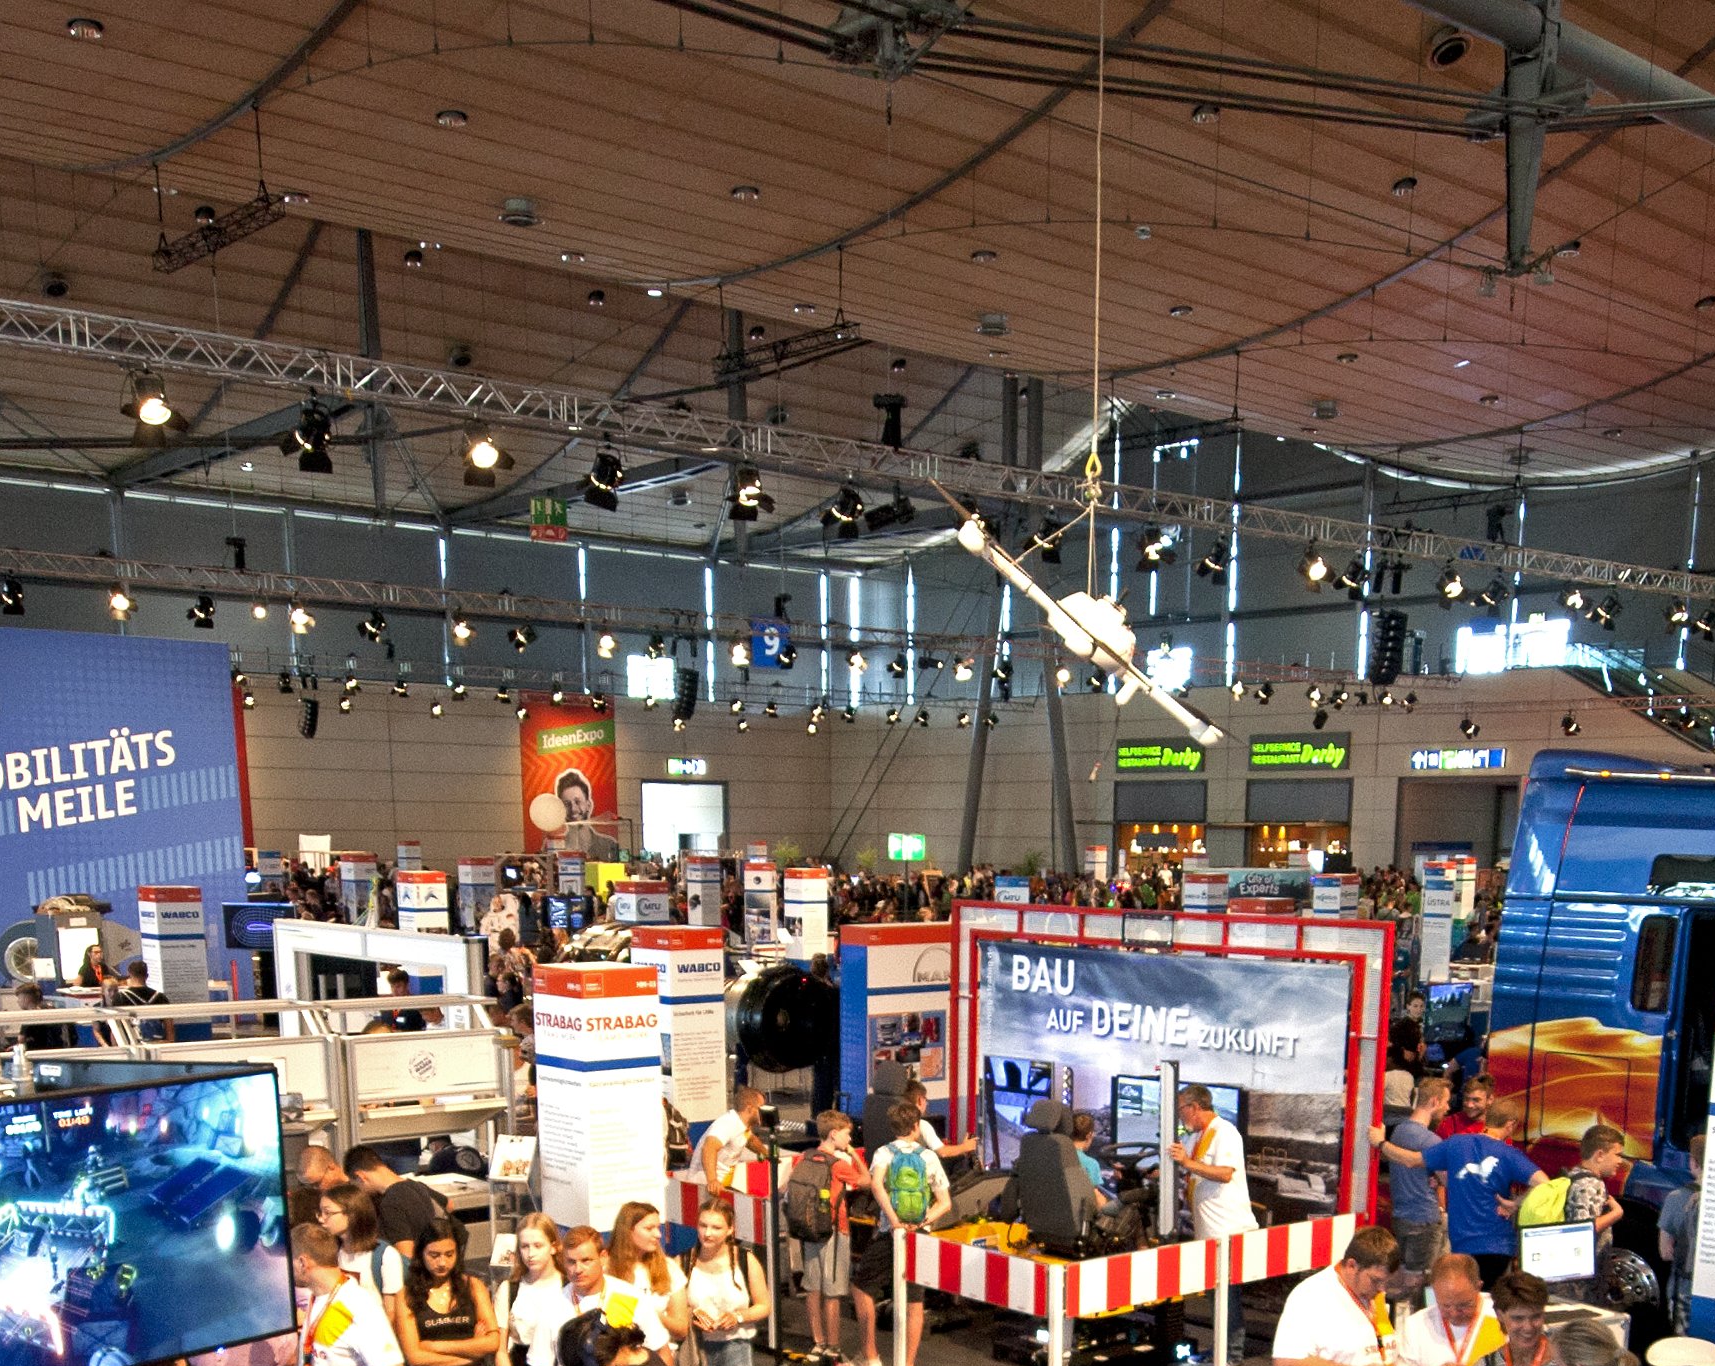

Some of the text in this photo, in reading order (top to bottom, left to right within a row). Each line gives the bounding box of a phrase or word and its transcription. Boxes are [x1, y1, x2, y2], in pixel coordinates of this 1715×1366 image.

[763, 627, 780, 656] 9
[542, 728, 604, 750] IdeenExpo
[1161, 747, 1201, 771] Derby
[1300, 743, 1345, 769] Derby
[17, 779, 137, 833] MEILE
[1240, 881, 1280, 897] Experts
[161, 911, 199, 919] WABCO
[677, 962, 721, 974] WABCO
[1012, 955, 1075, 996] BAU
[535, 1012, 582, 1032] STRABAG
[586, 1013, 658, 1032] STRABAG
[1047, 1001, 1299, 1058] AUF DEINE ZUKUNFT
